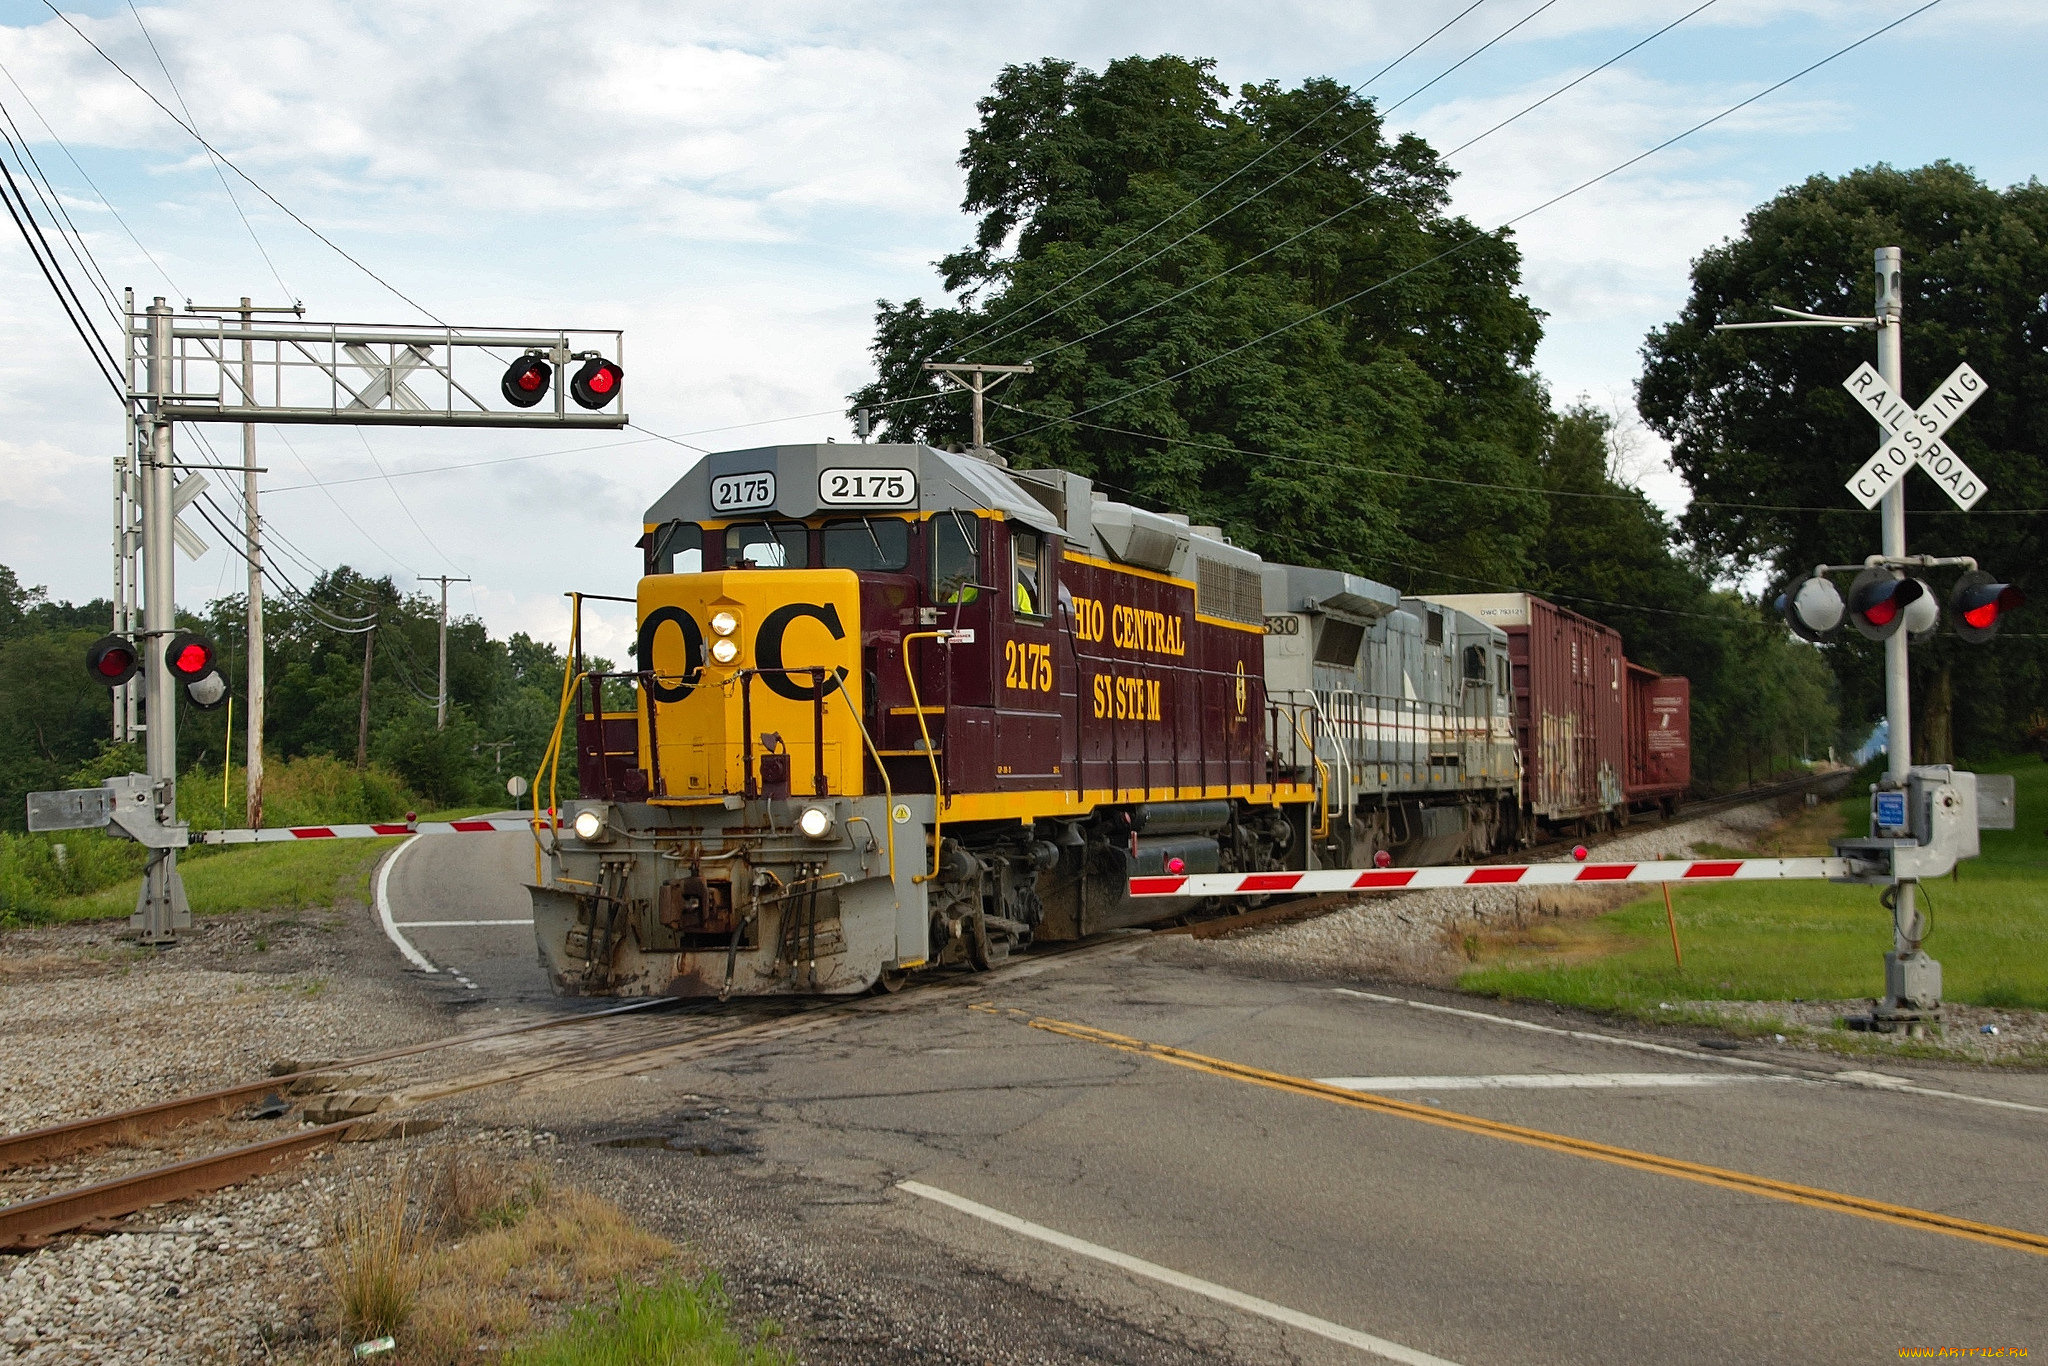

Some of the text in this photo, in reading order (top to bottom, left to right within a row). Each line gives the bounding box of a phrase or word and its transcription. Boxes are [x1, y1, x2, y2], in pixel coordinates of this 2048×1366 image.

[1852, 372, 1977, 501] RAIL ROAD
[1857, 372, 1978, 498] CROSSING
[719, 479, 769, 504] 2175
[831, 476, 905, 498] 2175
[1072, 596, 1185, 656] HIO CENTRAL
[1005, 639, 1053, 692] 2175
[1093, 673, 1161, 721] SYSTEM
